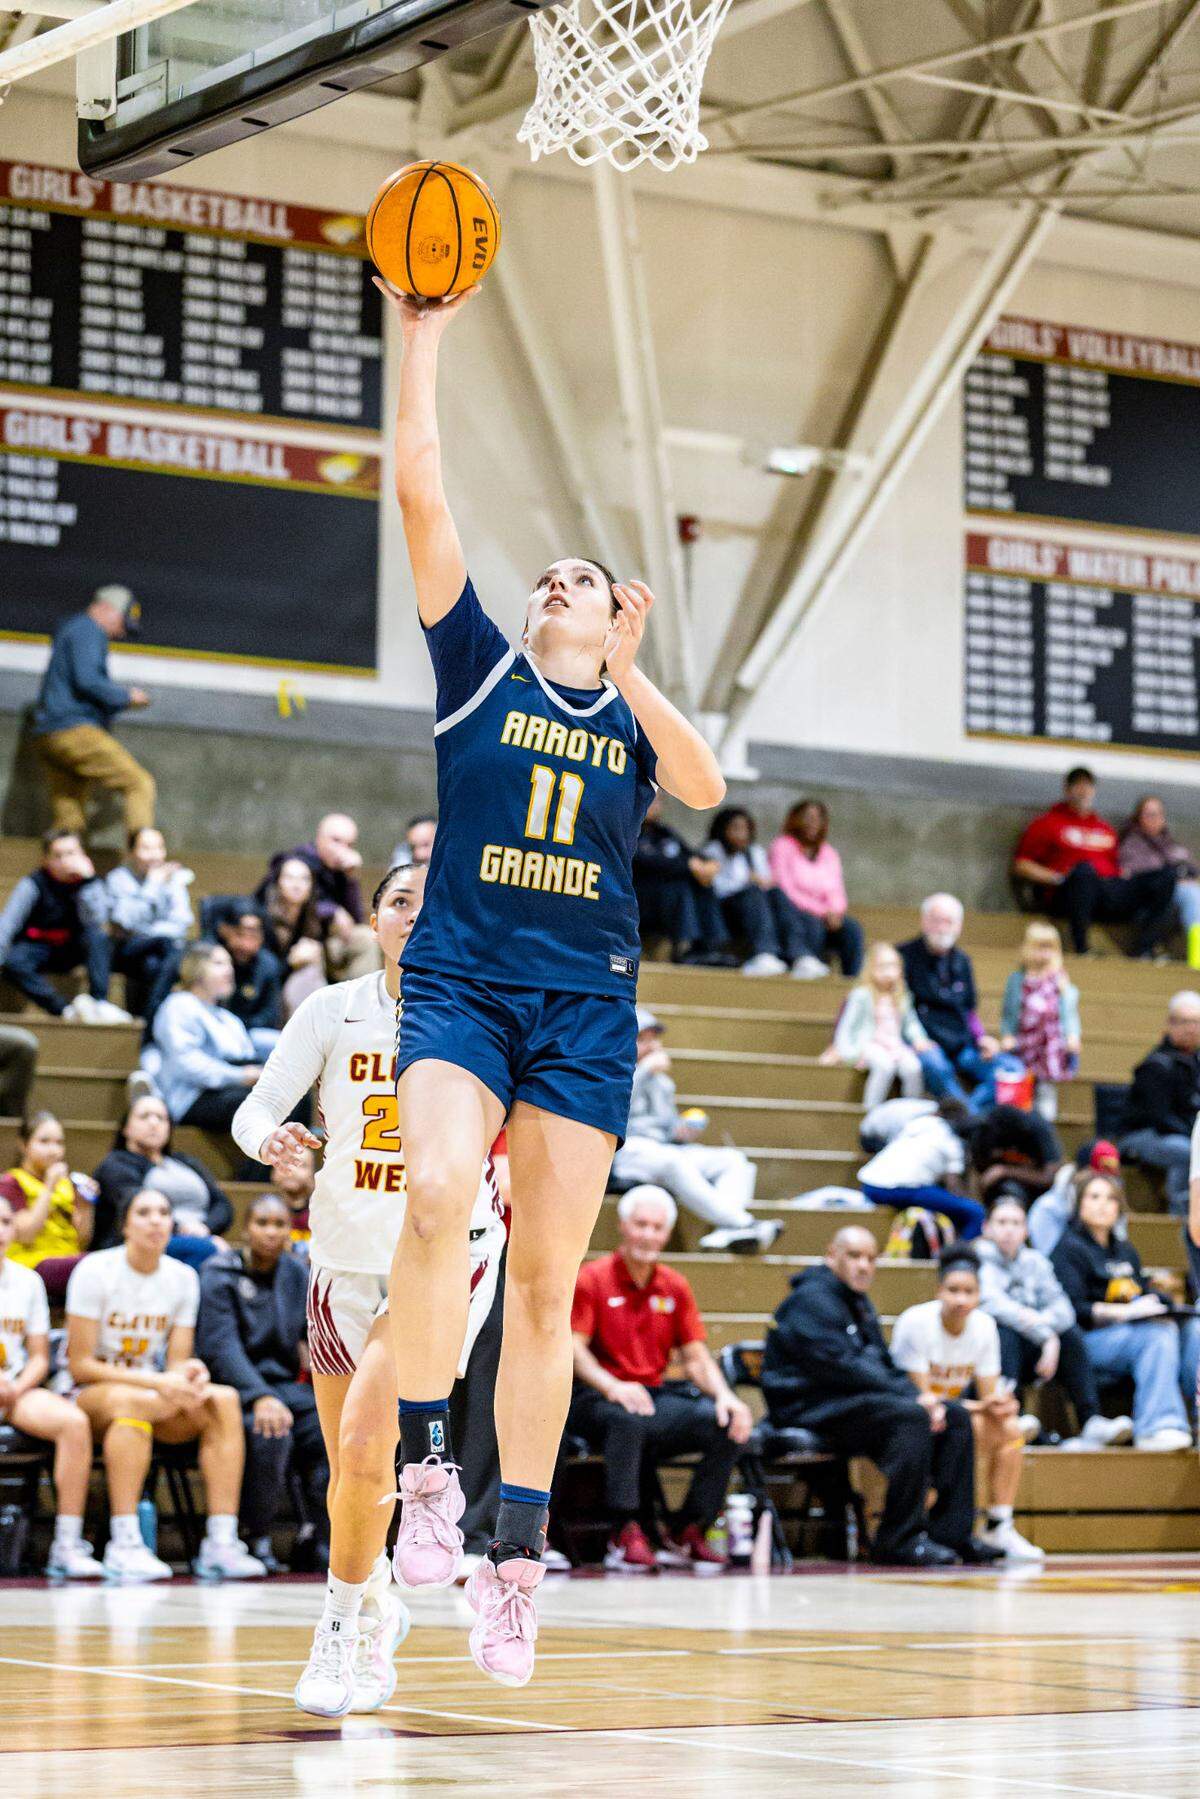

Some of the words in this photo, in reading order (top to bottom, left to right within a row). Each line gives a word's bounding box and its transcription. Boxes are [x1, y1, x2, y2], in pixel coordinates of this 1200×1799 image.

[112, 182, 294, 239] BASKETBALL
[107, 422, 292, 479] BASKETBALL
[500, 709, 627, 775] ARROYO
[524, 763, 585, 845] 11
[479, 843, 602, 901] GRANDE
[354, 1158, 407, 1193] WE
